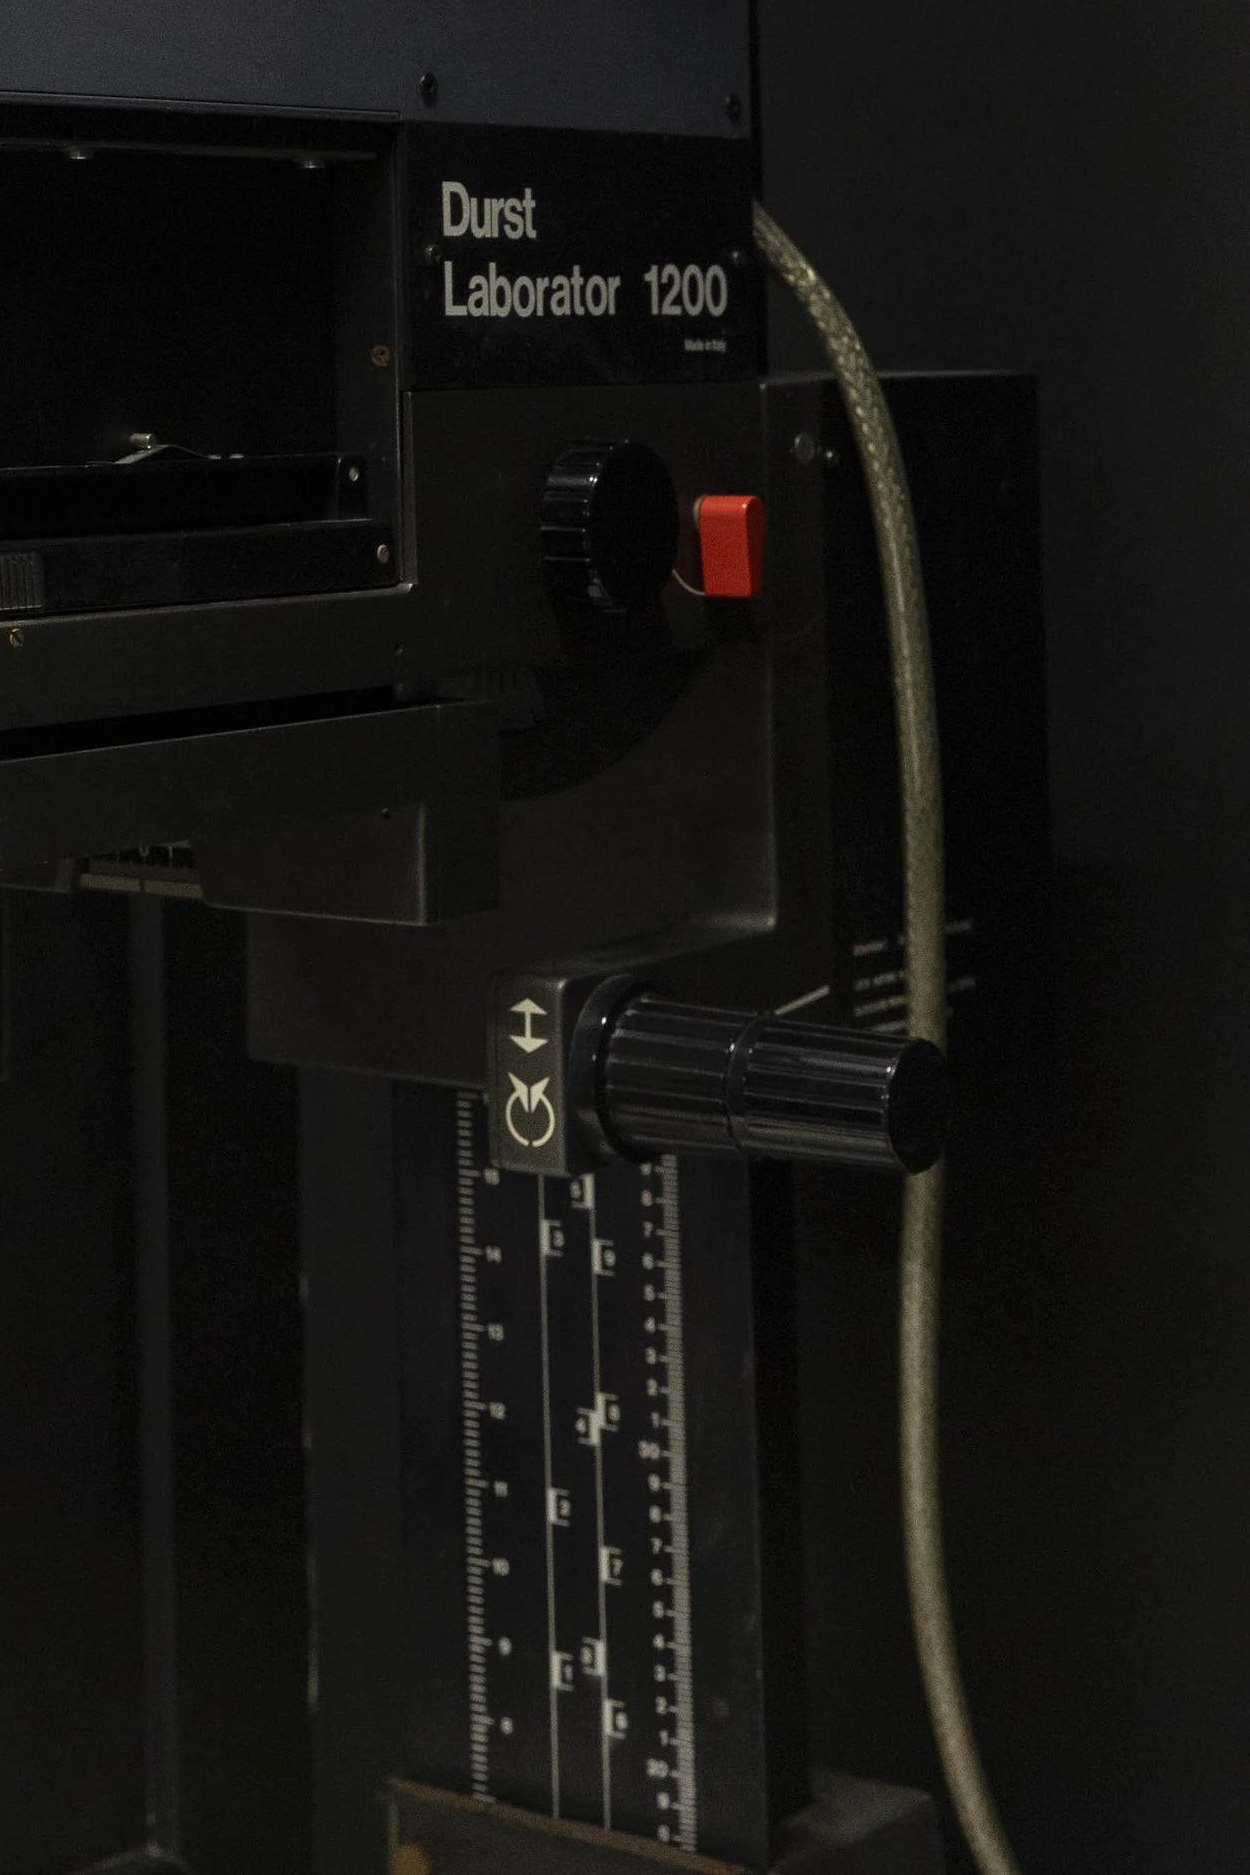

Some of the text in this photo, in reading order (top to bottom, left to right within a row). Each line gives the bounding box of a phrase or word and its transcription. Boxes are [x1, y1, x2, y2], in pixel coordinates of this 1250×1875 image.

[441, 180, 538, 240] Durst
[443, 260, 728, 318] Laborator 1200
